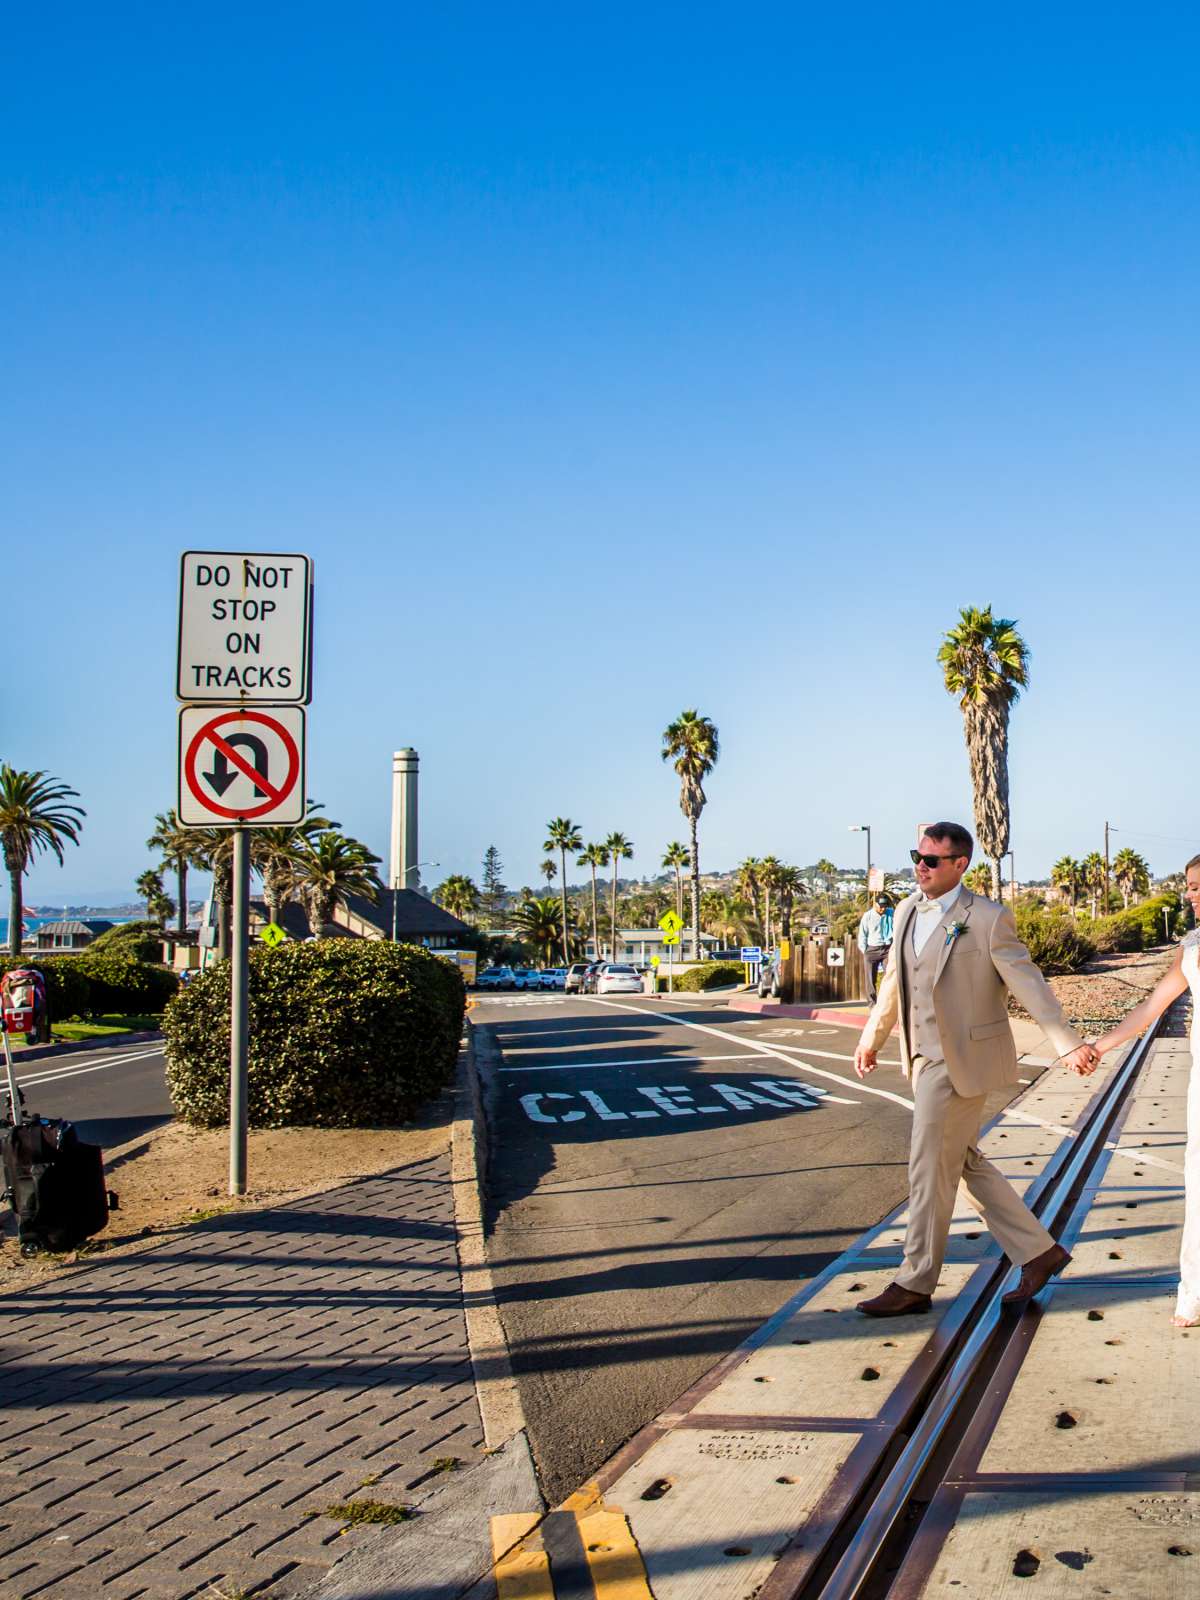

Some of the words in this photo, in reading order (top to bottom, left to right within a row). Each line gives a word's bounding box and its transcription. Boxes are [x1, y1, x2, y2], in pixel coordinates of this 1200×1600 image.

[196, 565, 231, 587] DO
[244, 566, 294, 589] NOT
[211, 598, 277, 621] STOP
[225, 632, 261, 654] ON
[191, 665, 292, 688] TRACKS
[518, 1080, 860, 1124] CLEAR
